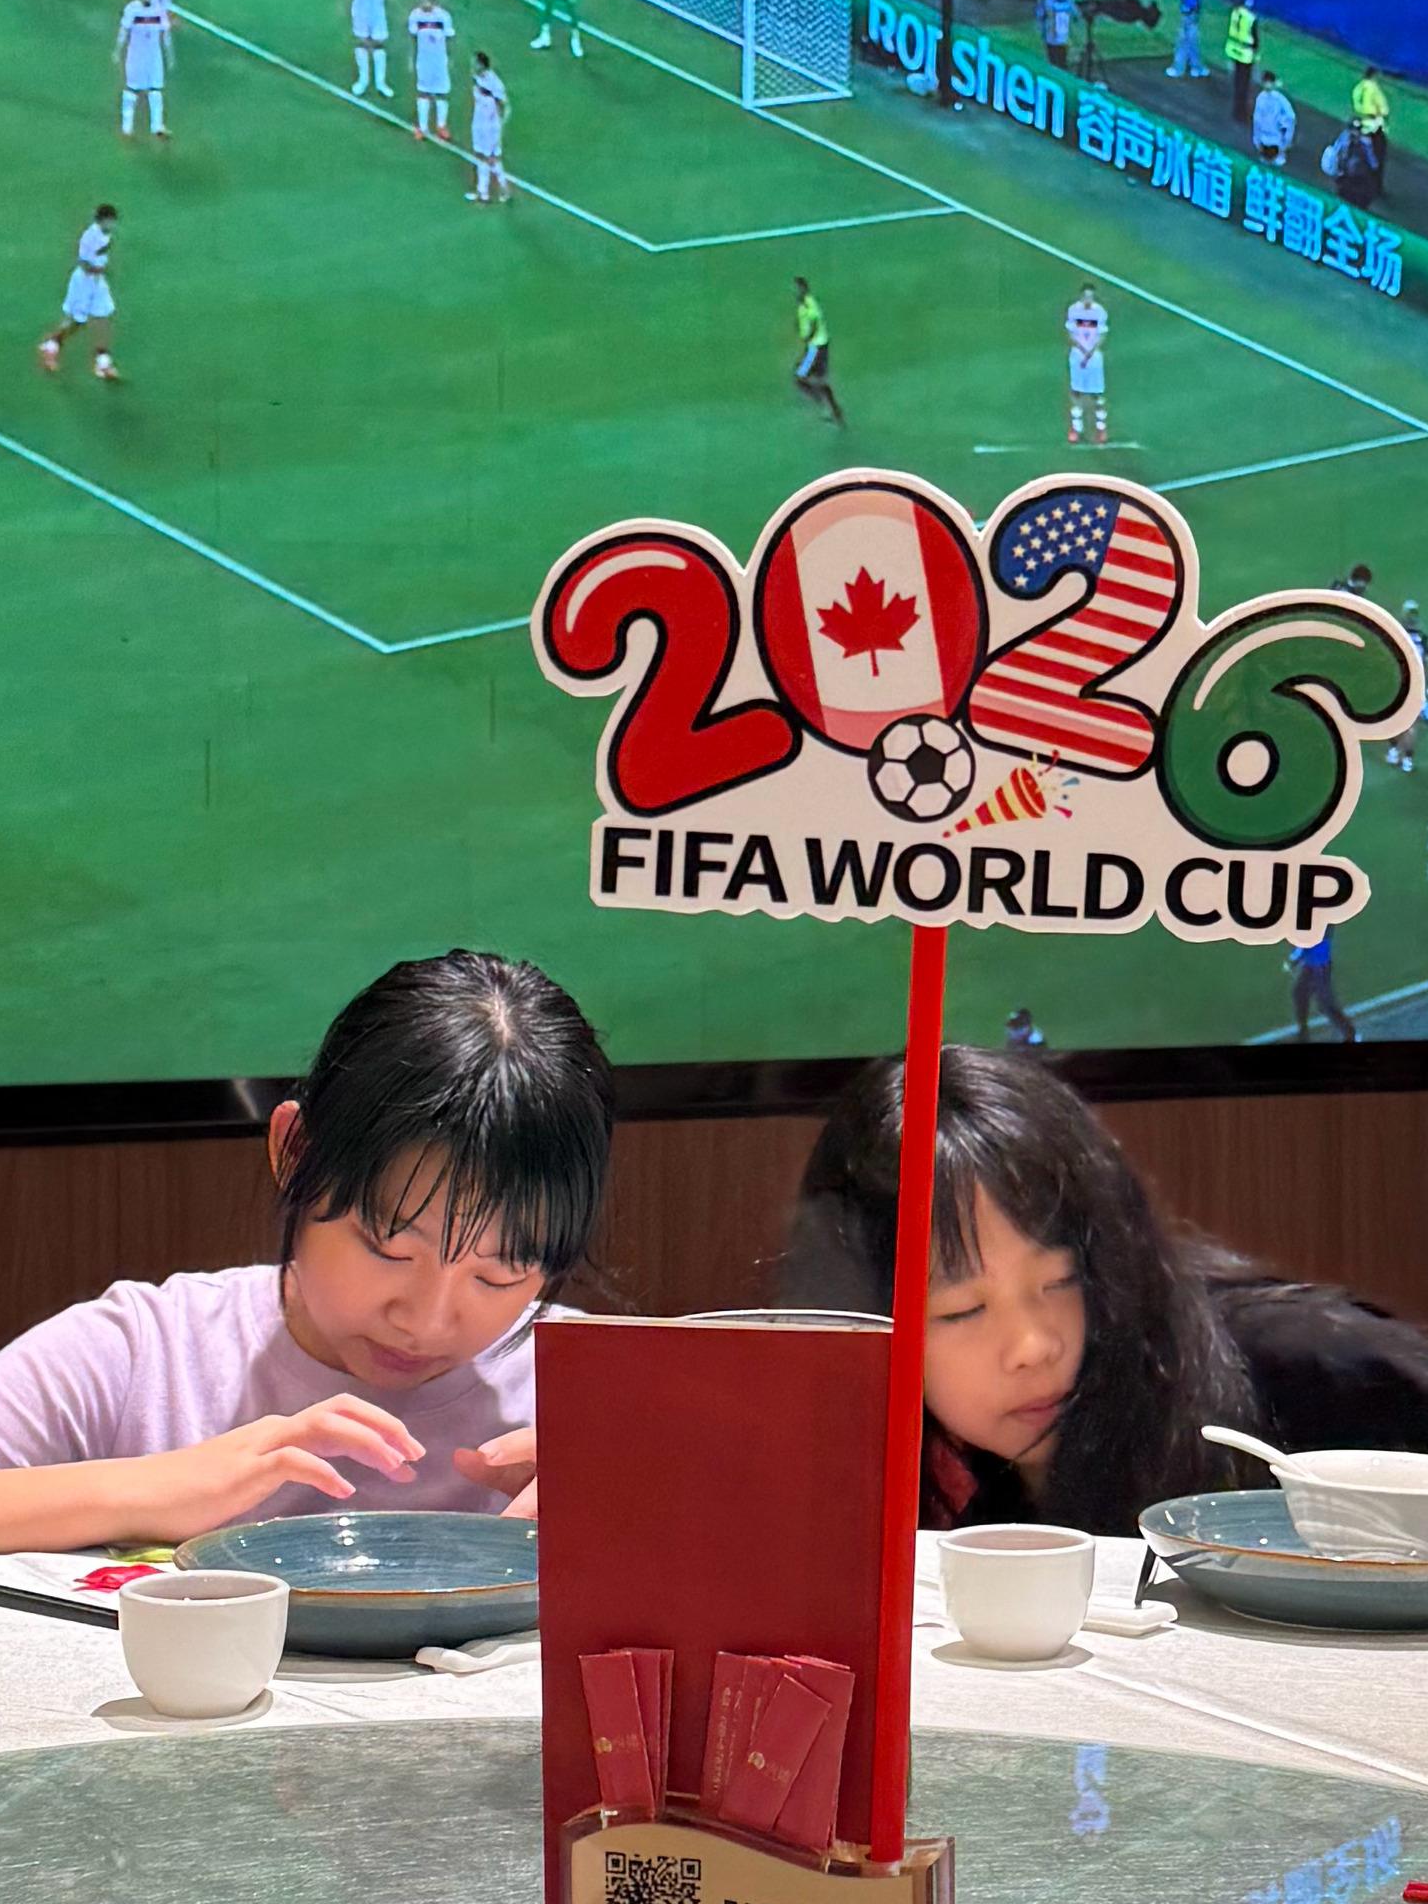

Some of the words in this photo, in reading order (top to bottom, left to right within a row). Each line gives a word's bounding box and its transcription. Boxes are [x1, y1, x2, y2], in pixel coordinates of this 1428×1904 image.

[1077, 89, 1233, 218] 容声冰箱
[1244, 166, 1403, 297] 鲜翻全场
[543, 480, 1412, 852] 2026
[599, 825, 787, 903] FIFA
[805, 835, 1145, 920] WORLD
[1164, 856, 1354, 934] CUP
